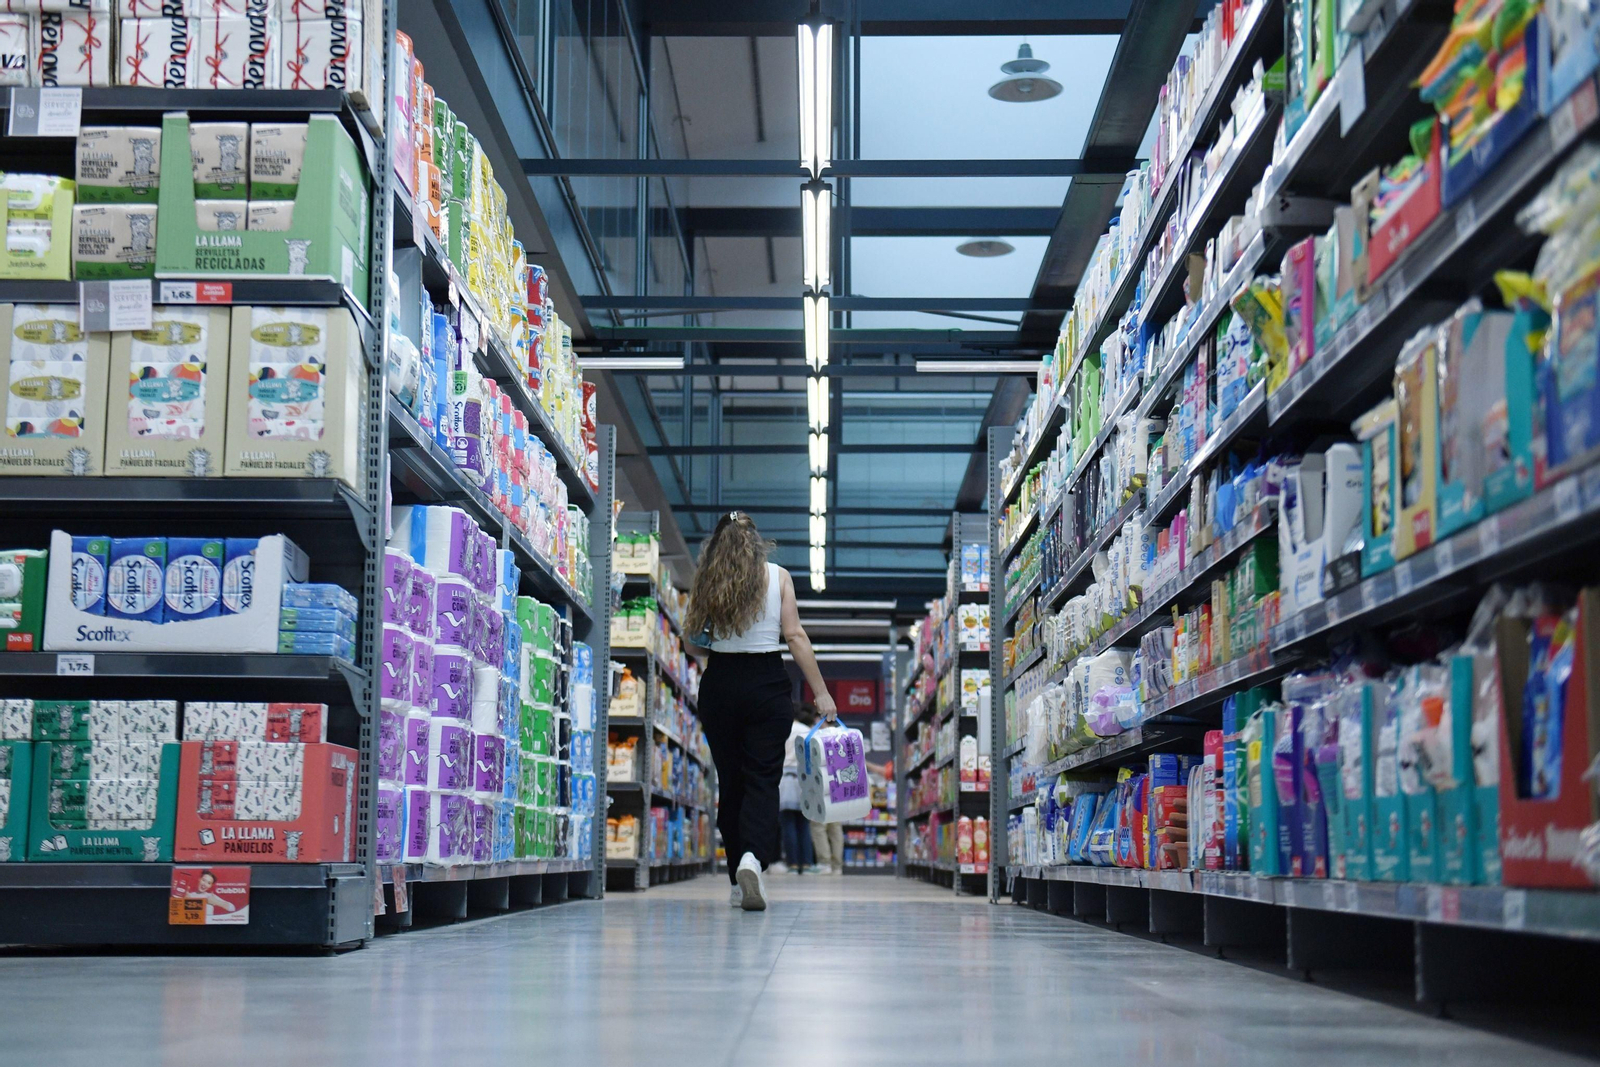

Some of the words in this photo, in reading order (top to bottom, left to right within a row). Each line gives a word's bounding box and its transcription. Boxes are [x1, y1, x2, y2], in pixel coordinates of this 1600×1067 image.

[195, 235, 208, 247] LA
[210, 235, 243, 247] LLAMA
[195, 248, 240, 257] SERVILLETAS
[195, 258, 266, 270] RECICLADAS
[132, 450, 155, 458] LLAMA
[120, 458, 153, 467] PAÑUELOS
[154, 459, 186, 467] FACIALES
[125, 560, 142, 609] Scottex
[182, 560, 199, 609] Scottex
[241, 560, 255, 609] Scottex
[76, 625, 133, 642] Scottex
[221, 827, 236, 840] LA
[238, 827, 275, 841] LLAMA
[82, 837, 92, 846] LA
[94, 837, 120, 847] LLAMA
[224, 840, 274, 854] PAÑUELOS
